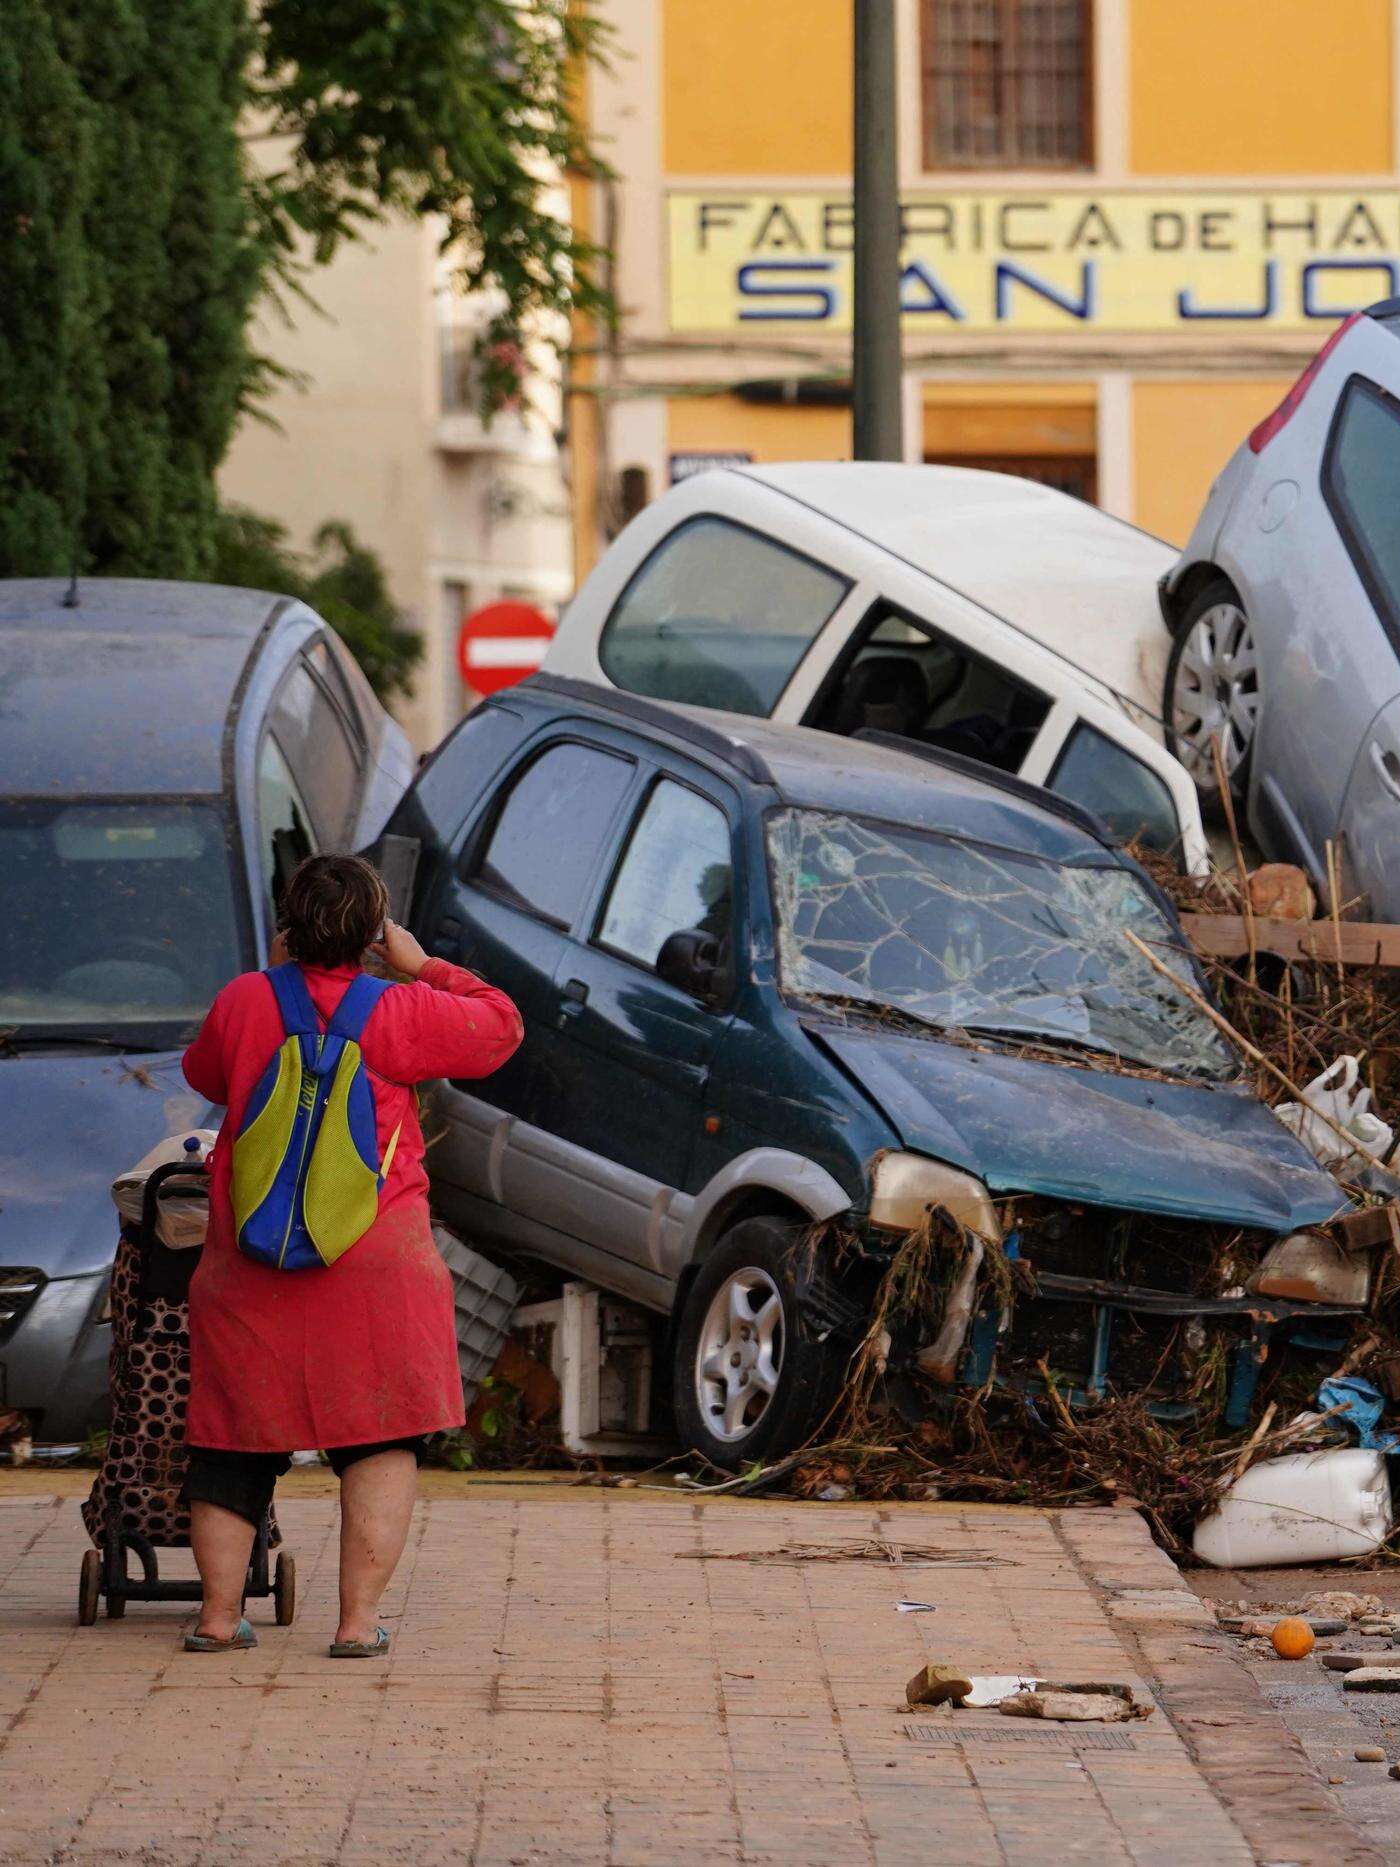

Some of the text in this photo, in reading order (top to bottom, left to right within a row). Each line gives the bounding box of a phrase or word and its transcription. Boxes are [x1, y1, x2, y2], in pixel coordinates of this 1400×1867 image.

[698, 203, 1122, 251] FABRICA
[1151, 212, 1232, 250] DE
[736, 260, 1096, 320] SAN
